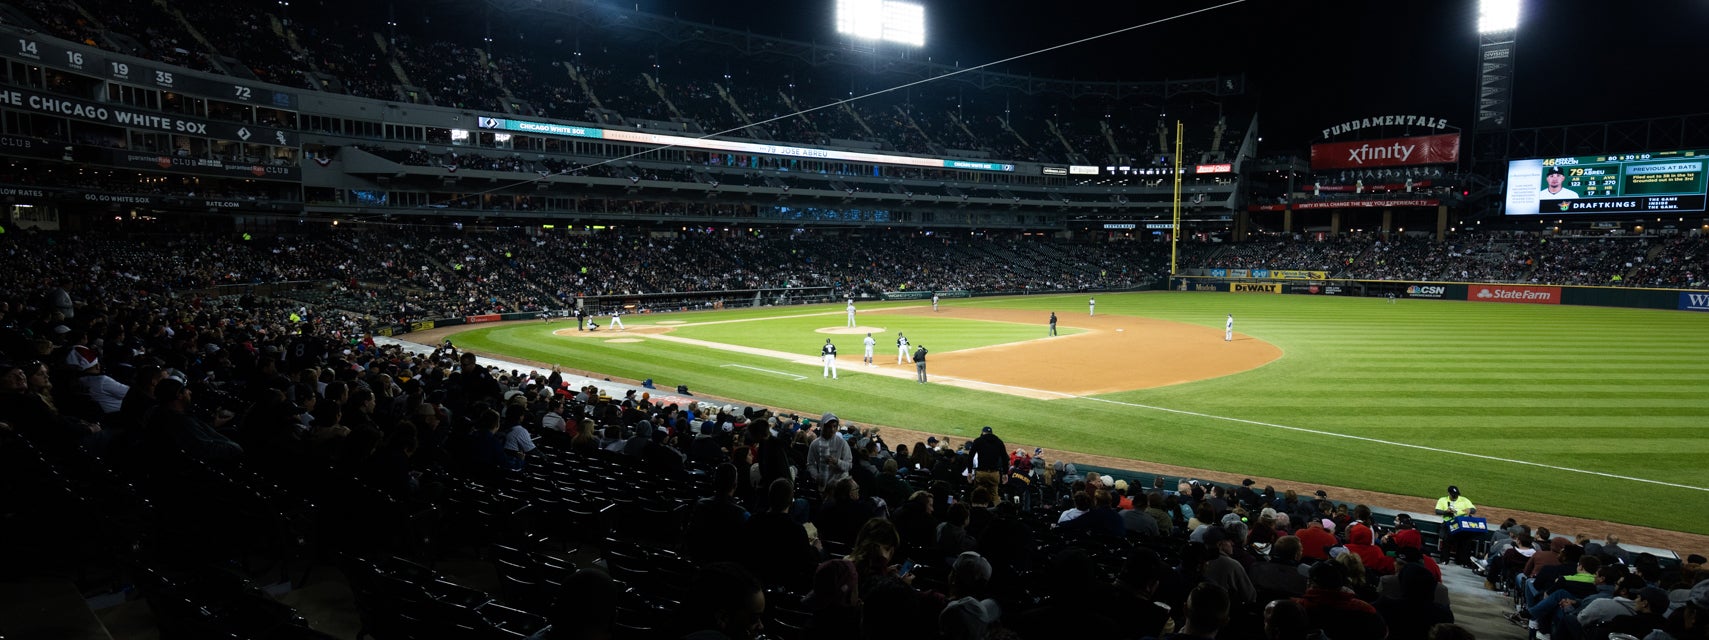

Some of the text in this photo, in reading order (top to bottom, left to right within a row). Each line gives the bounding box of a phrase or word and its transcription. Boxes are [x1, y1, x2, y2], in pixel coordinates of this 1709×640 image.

[19, 40, 38, 54] 14
[66, 50, 84, 65] 16
[112, 62, 128, 75] 19
[155, 70, 173, 84] 35
[234, 86, 251, 98] 72
[29, 95, 108, 121] CHICAGO
[114, 110, 172, 130] WHITE
[176, 119, 207, 134] SOX
[520, 122, 550, 131] CHICAGO
[550, 124, 571, 134] WHITE
[1322, 115, 1448, 138] FUNDAMENTALS
[1, 137, 32, 148] CLUB
[802, 149, 828, 157] ABREU
[1348, 142, 1416, 164] xfinity
[172, 158, 197, 166] CLUB
[1420, 286, 1445, 294] CSN
